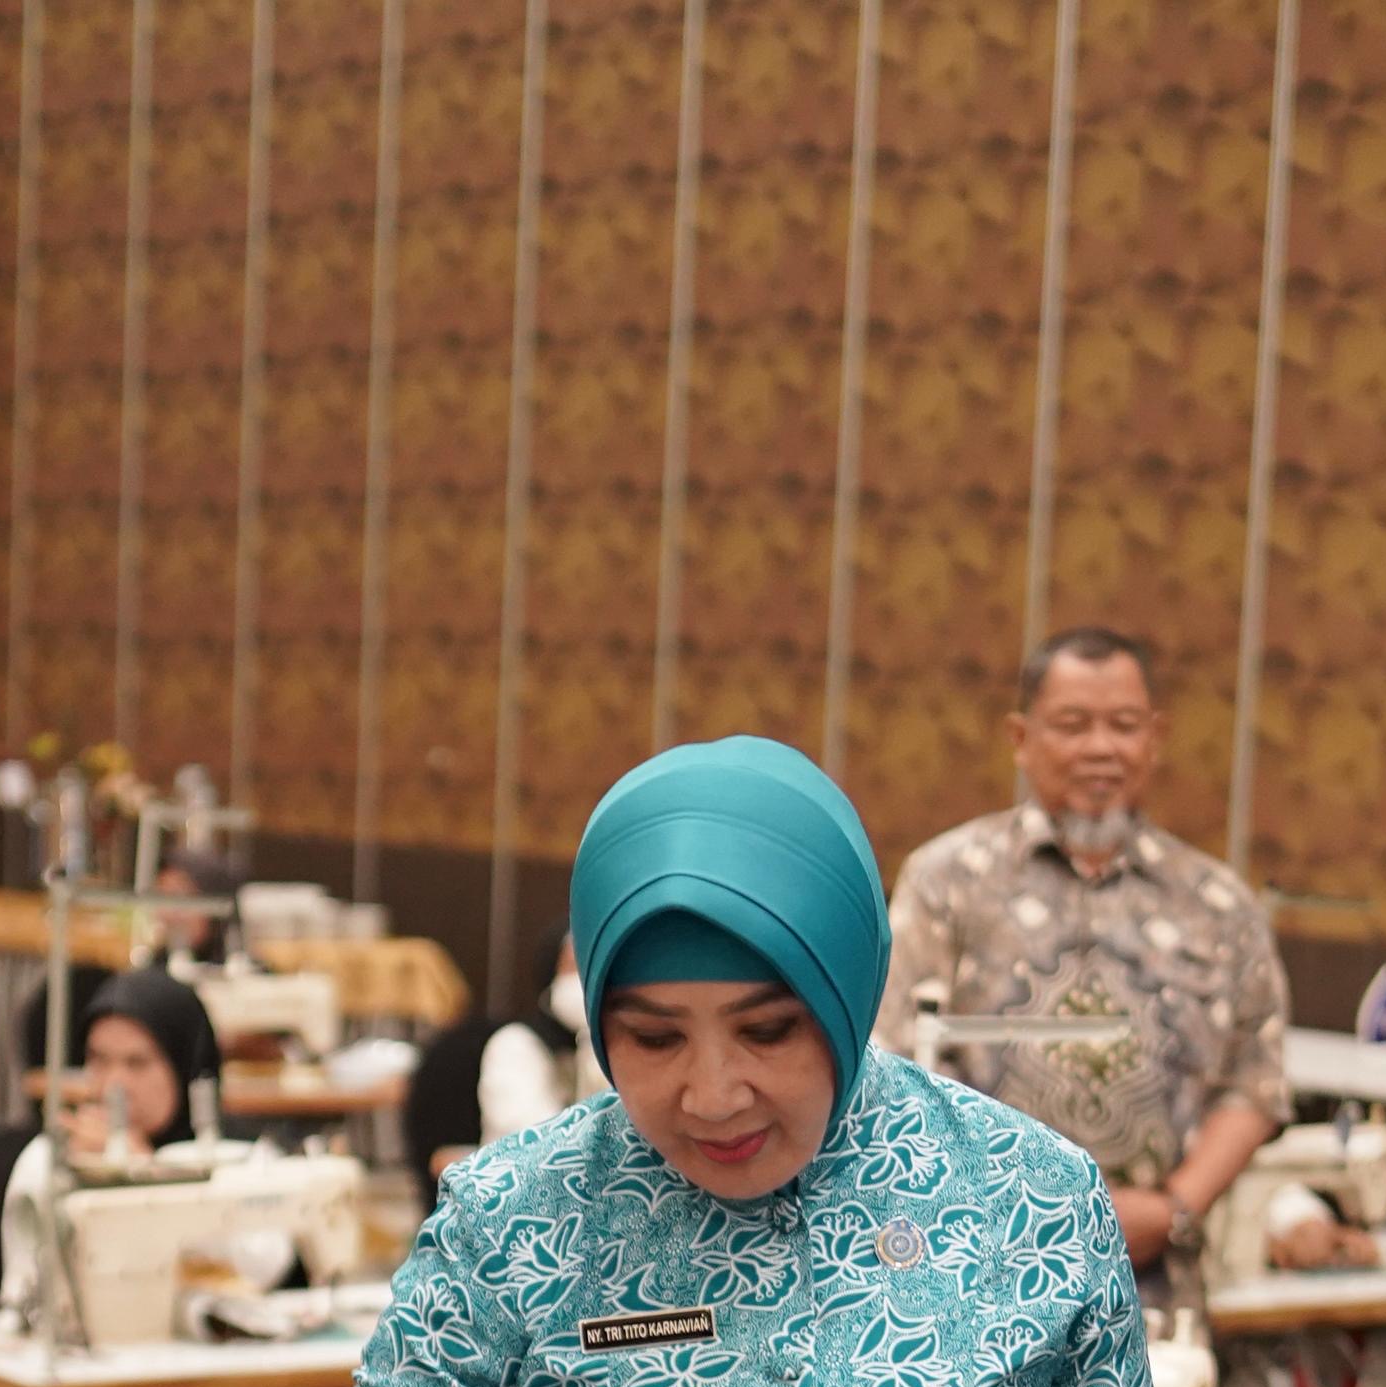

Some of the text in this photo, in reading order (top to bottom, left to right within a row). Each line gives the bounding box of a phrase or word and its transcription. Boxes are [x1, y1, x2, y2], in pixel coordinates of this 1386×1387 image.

[586, 1316, 709, 1344] NY. TRI TITO KARNAVIAN
